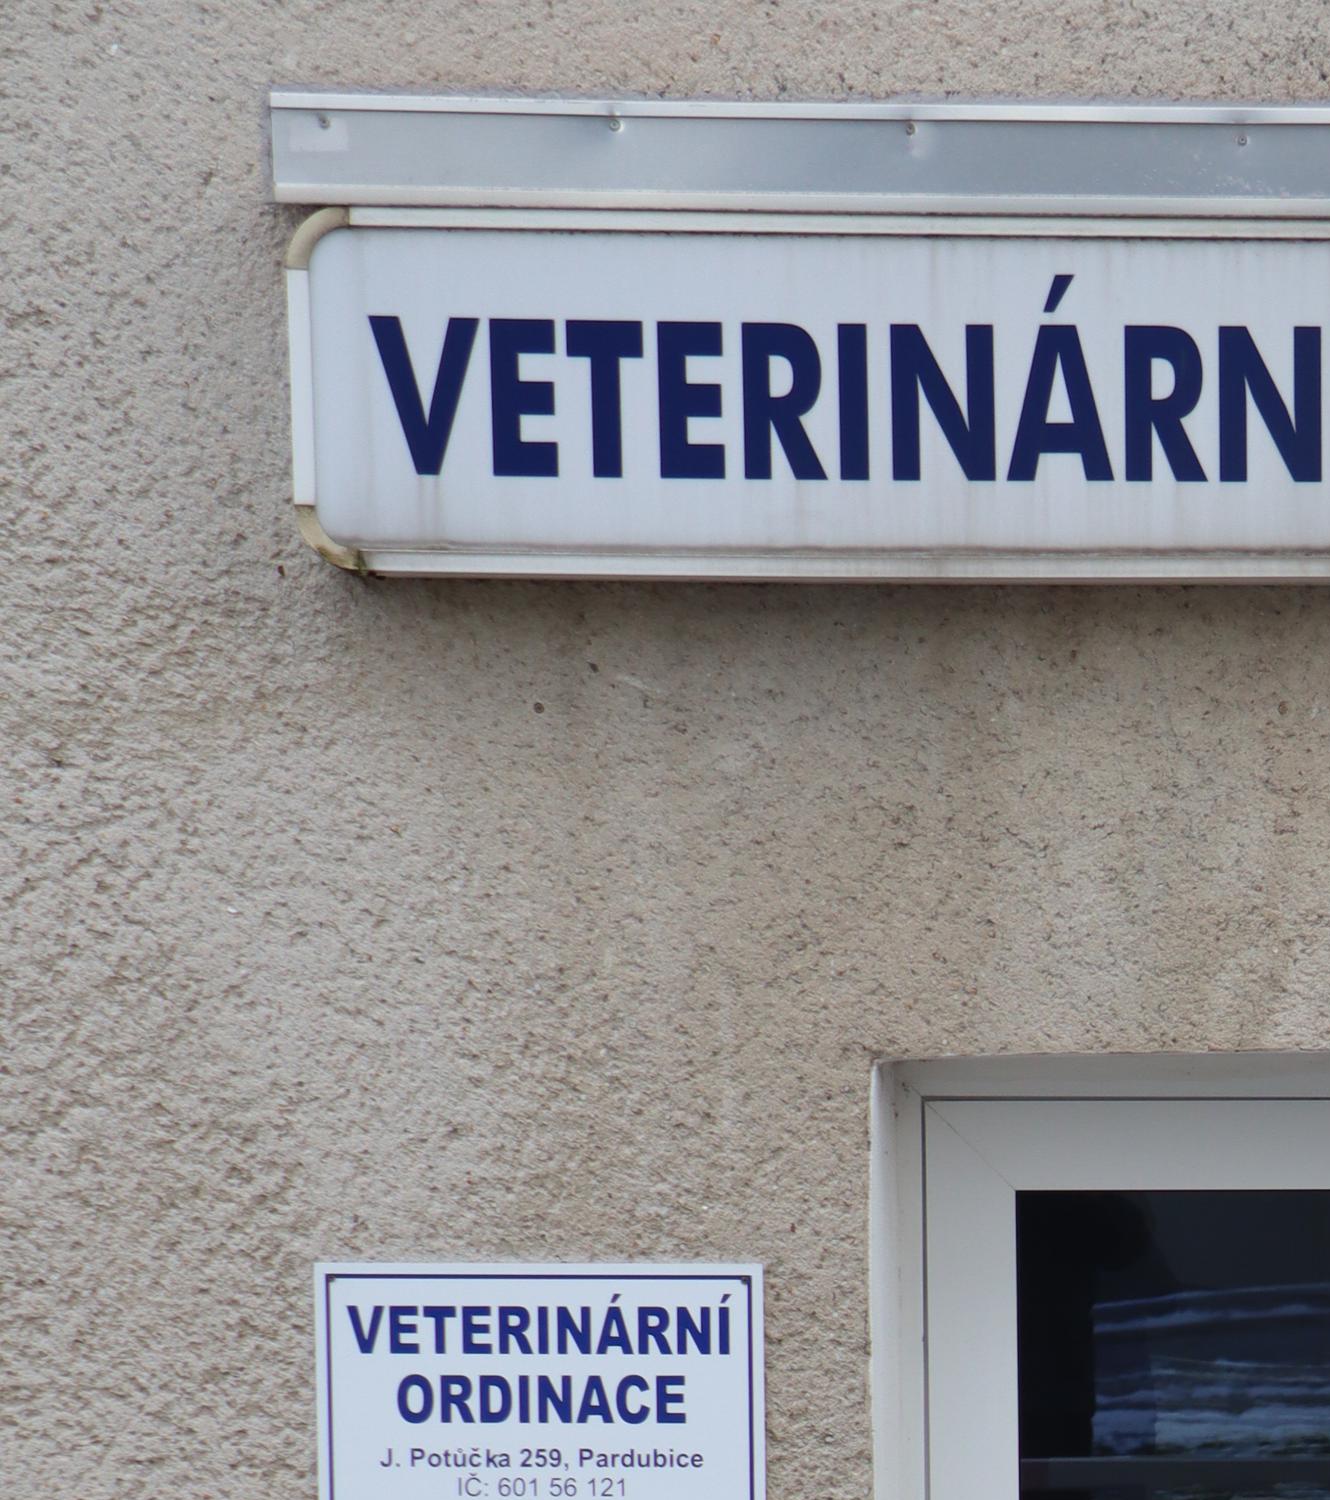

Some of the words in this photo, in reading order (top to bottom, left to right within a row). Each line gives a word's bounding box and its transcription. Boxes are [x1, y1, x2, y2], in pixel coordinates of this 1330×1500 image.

[346, 1293, 732, 1356] VETERINÁRNÍ
[396, 1373, 688, 1425] ORDINACE
[379, 1448, 401, 1468] J.
[410, 1447, 511, 1469] Potůčka
[519, 1448, 570, 1471] 259,
[579, 1448, 704, 1468] Pardubice
[457, 1473, 489, 1497] IČ:
[497, 1477, 539, 1497] 601
[549, 1477, 577, 1498] 56
[587, 1477, 626, 1497] 121
